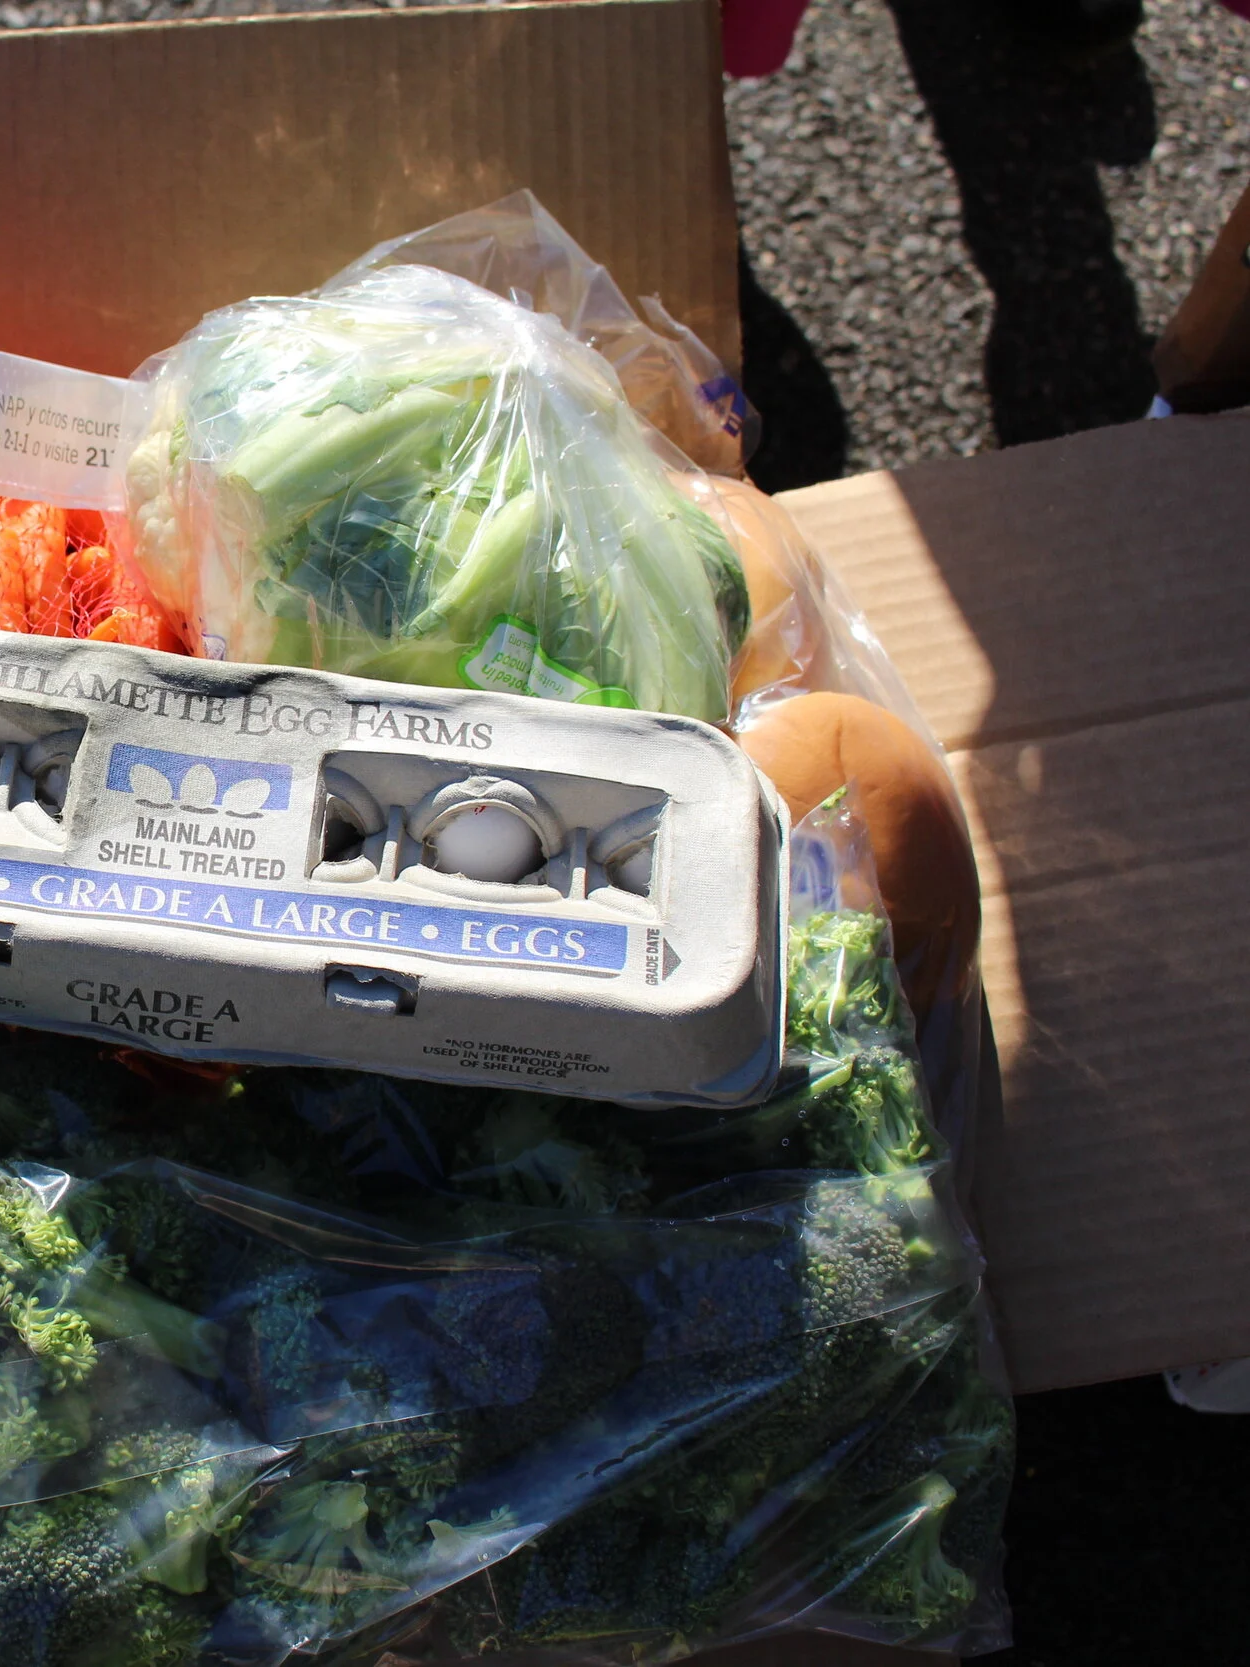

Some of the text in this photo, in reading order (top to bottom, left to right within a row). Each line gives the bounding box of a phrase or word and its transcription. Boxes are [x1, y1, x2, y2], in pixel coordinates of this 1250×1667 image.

[26, 406, 36, 422] y
[38, 406, 69, 430] otros
[4, 428, 28, 455] 2-1-1
[32, 441, 42, 456] o
[44, 440, 79, 465] visite
[481, 663, 496, 680] in
[235, 693, 332, 737] EGG
[345, 700, 493, 750] FARMS
[135, 817, 256, 851] MAINLAND
[98, 840, 286, 881] SHELL TREATED
[31, 875, 192, 917] GRADE
[203, 894, 235, 924] A
[252, 898, 402, 942] LARGE
[461, 921, 586, 961] EGGS
[645, 928, 660, 986] GRADE DATE
[66, 979, 240, 1023] GRADE A
[90, 1005, 214, 1043] LARGE
[422, 1046, 610, 1074] USED IN THE PRODUCTION
[460, 1059, 479, 1068] OF
[482, 1061, 522, 1074] SHELL
[478, 1042, 561, 1060] HORMONES
[562, 1052, 592, 1062] ARE
